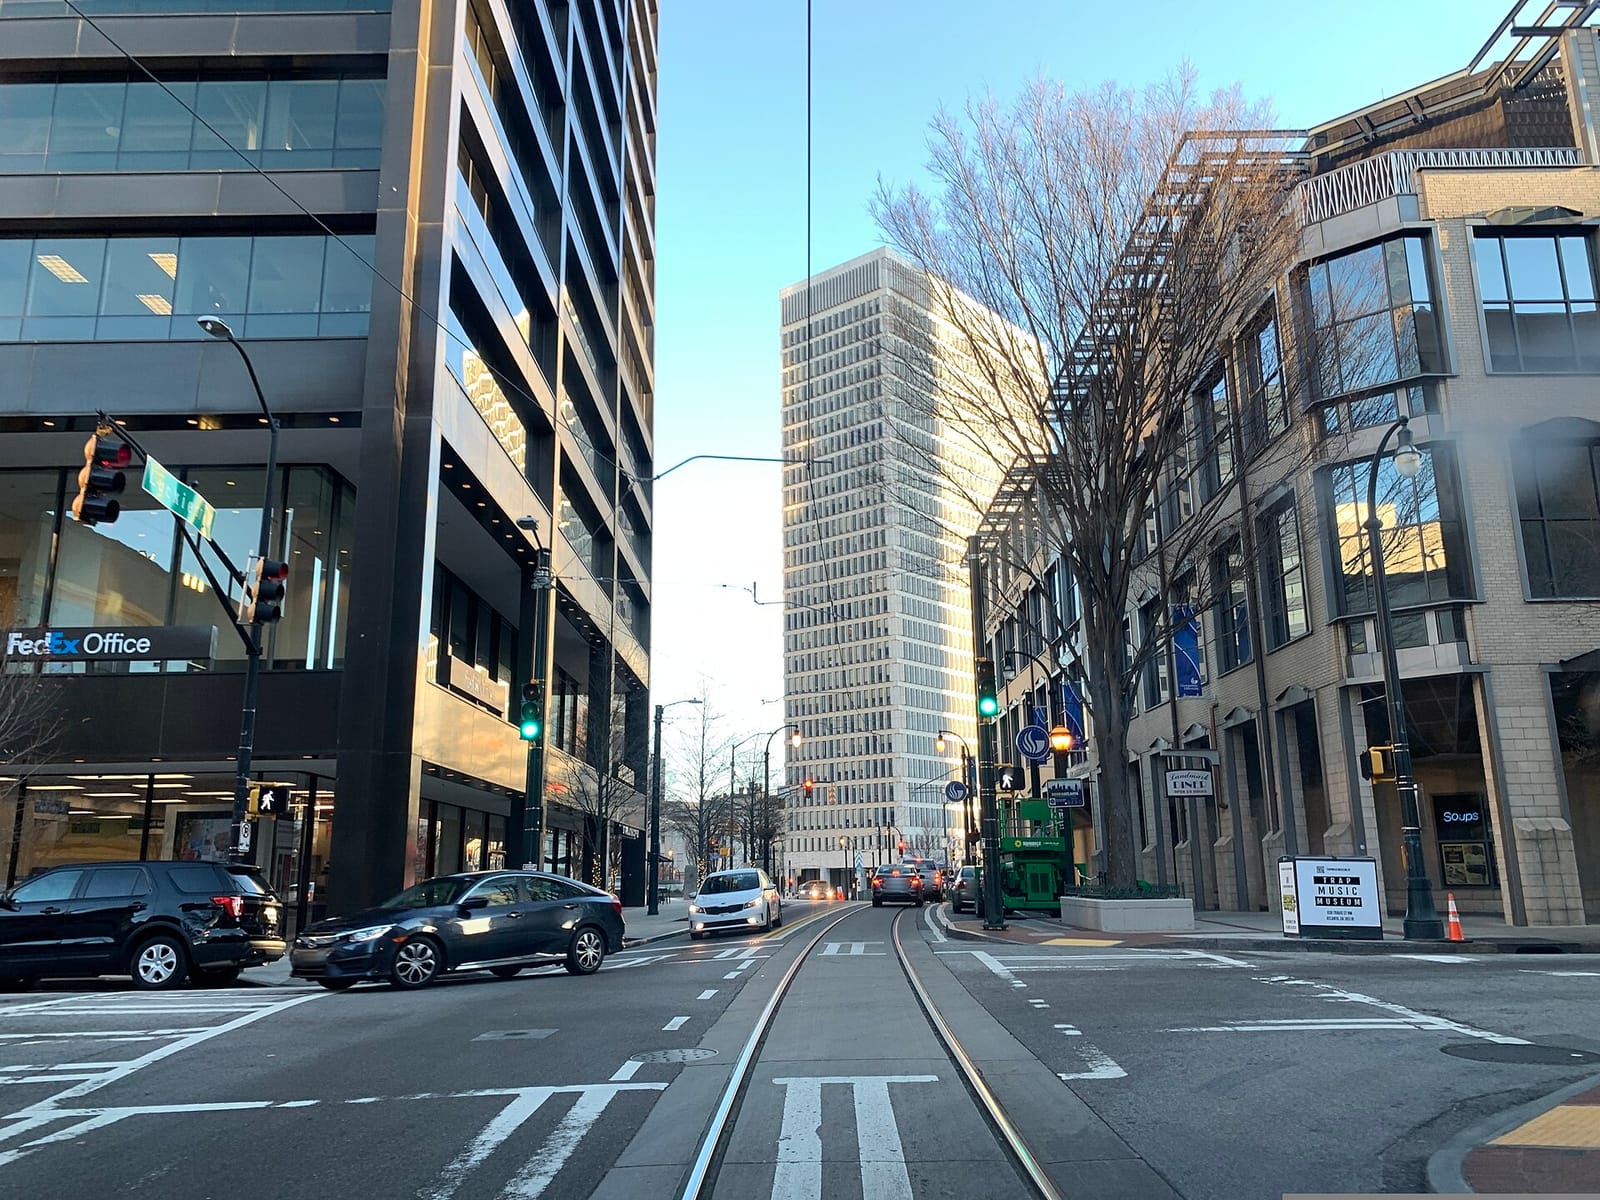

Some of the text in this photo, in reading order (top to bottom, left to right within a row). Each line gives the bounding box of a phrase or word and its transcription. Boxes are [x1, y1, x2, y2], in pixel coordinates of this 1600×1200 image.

[7, 631, 151, 655] FedEx Office
[1173, 781, 1207, 789] DINER
[1443, 811, 1479, 823] Soups
[1322, 876, 1351, 885] TRAP
[1318, 886, 1358, 896] MUSIC
[1316, 897, 1361, 907] MUSEUM
